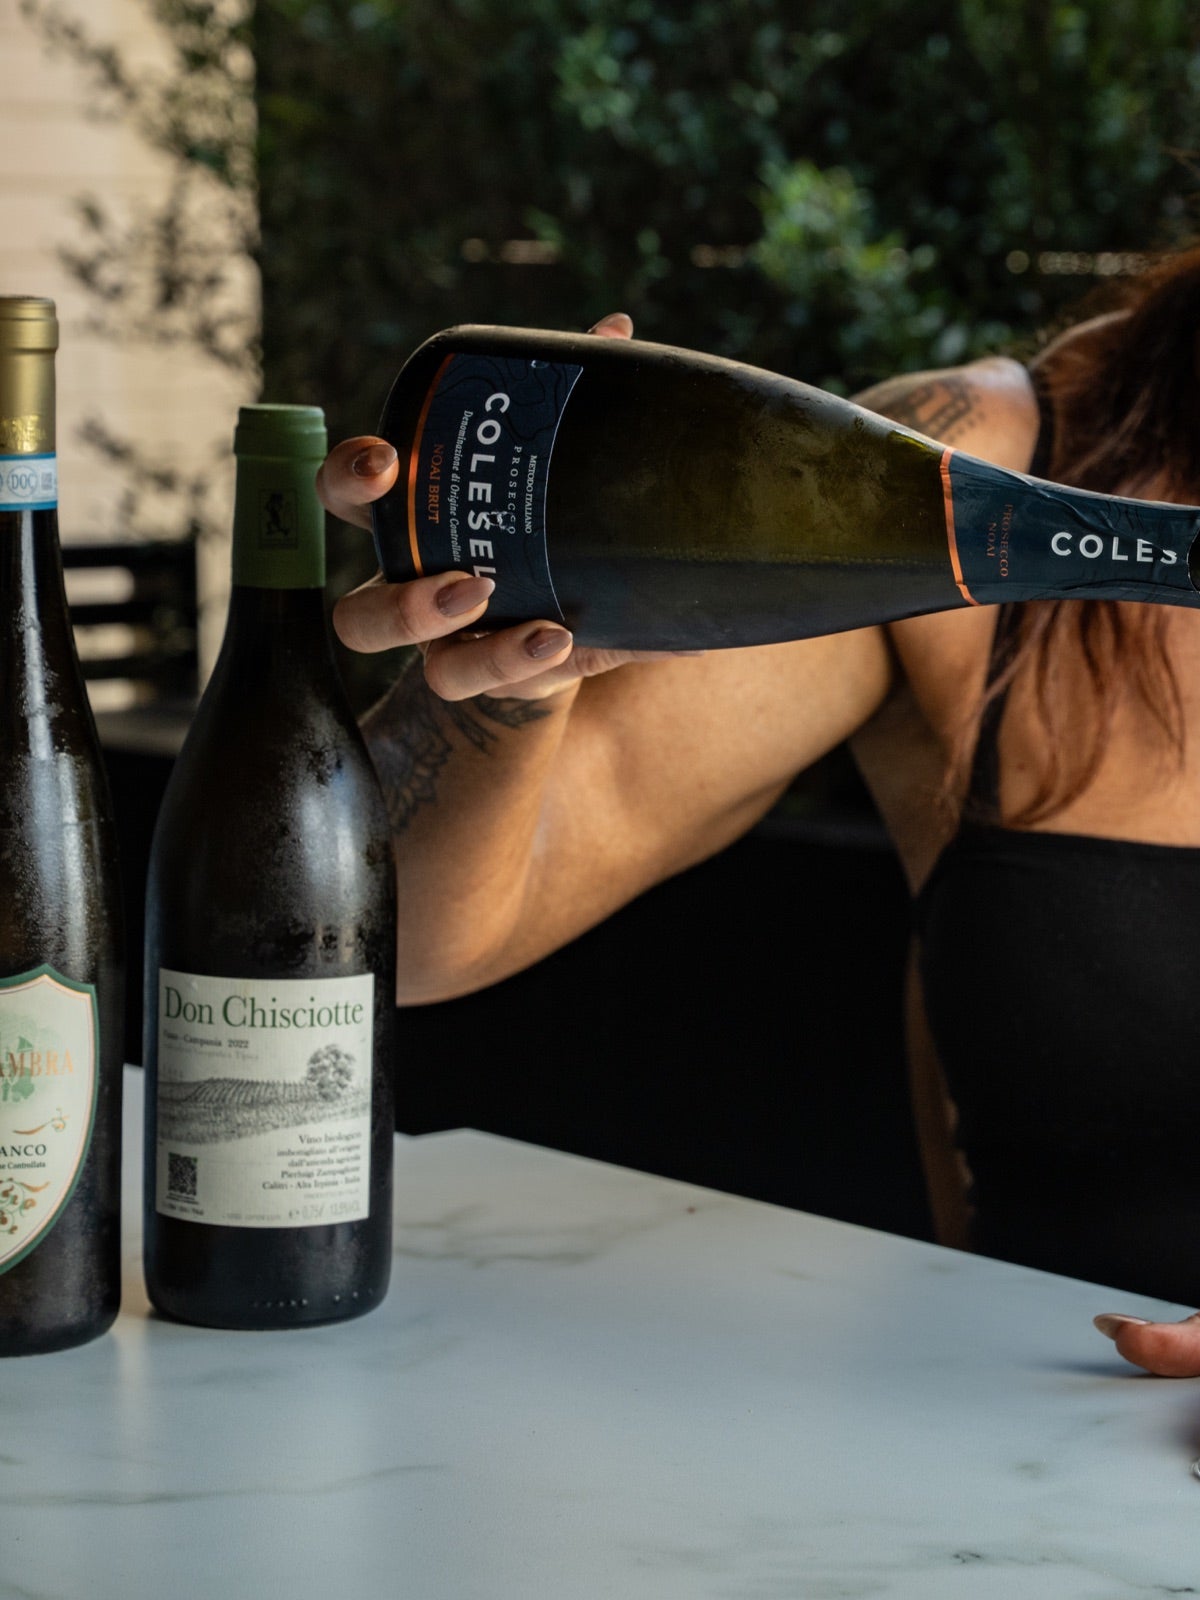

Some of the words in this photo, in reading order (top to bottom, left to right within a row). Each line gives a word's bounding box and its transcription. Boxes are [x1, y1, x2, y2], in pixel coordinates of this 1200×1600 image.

[452, 410, 473, 471] Denominazione
[11, 474, 37, 489] DOC
[451, 473, 461, 482] di
[467, 392, 510, 577] COLESEL
[507, 446, 522, 534] PROSECCO
[526, 455, 537, 492] METODO
[428, 485, 440, 524] BRUT
[448, 485, 460, 516] Origine
[450, 518, 461, 562] Controllata
[987, 522, 997, 558] NOAI
[1000, 504, 1013, 577] PROSECCO
[164, 986, 214, 1025] Don
[222, 995, 364, 1029] Chisciotte
[228, 1039, 249, 1048] 2022
[299, 1134, 322, 1144] Vino
[7, 1161, 46, 1170] Controllata
